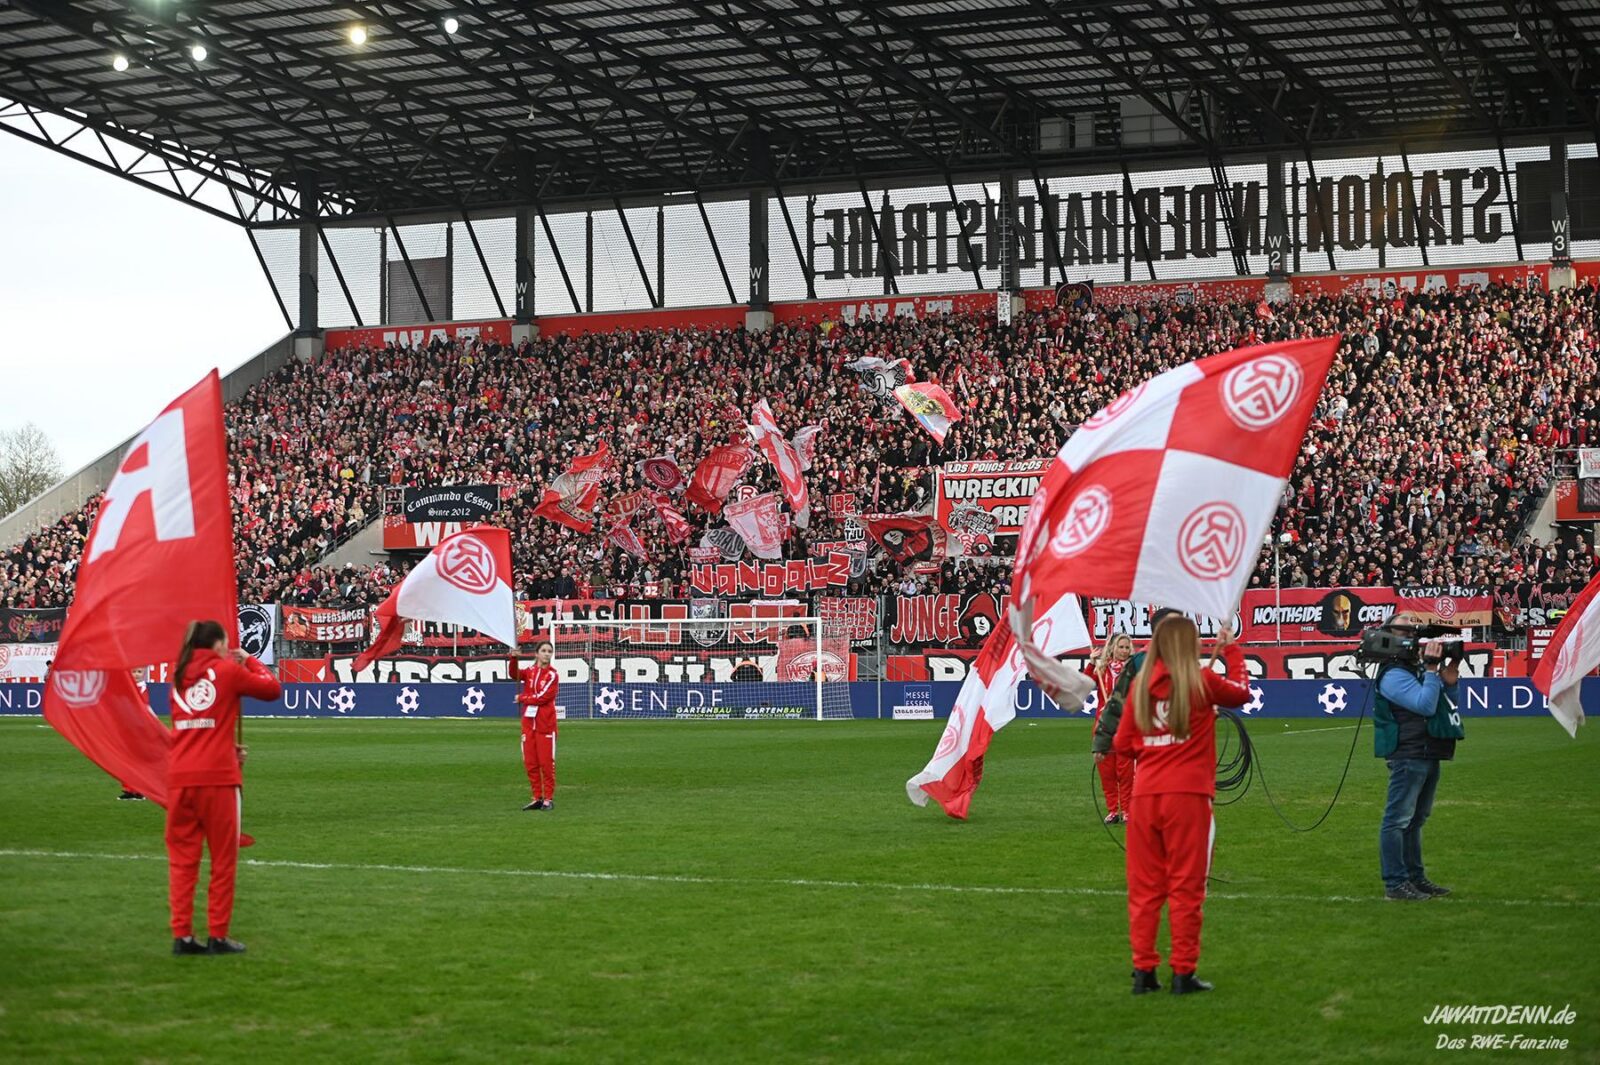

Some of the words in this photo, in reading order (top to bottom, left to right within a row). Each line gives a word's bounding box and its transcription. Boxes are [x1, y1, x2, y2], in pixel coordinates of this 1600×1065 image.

[1551, 219, 1567, 234] W
[1268, 235, 1283, 250] W
[1553, 235, 1566, 251] 3
[1270, 250, 1282, 267] 2
[750, 266, 762, 280] W
[515, 281, 528, 295] W
[948, 463, 969, 474] LOS
[1008, 460, 1043, 472] LOCOS
[944, 476, 1045, 499] WRECKIN
[406, 491, 461, 513] Commando
[464, 493, 494, 511] Essen
[428, 508, 449, 518] Since
[450, 507, 471, 517] 2012
[992, 505, 1031, 527] CRE
[530, 602, 614, 636] FANS
[890, 593, 961, 644] JUNGE
[1253, 605, 1323, 625] NORTHSIDE
[1358, 604, 1395, 622] CREW
[316, 623, 364, 641] ESSEN
[284, 690, 337, 710] UNS
[905, 691, 930, 699] MESSE
[676, 706, 732, 714] GARTENBAU
[745, 706, 803, 714] GARTENBAU
